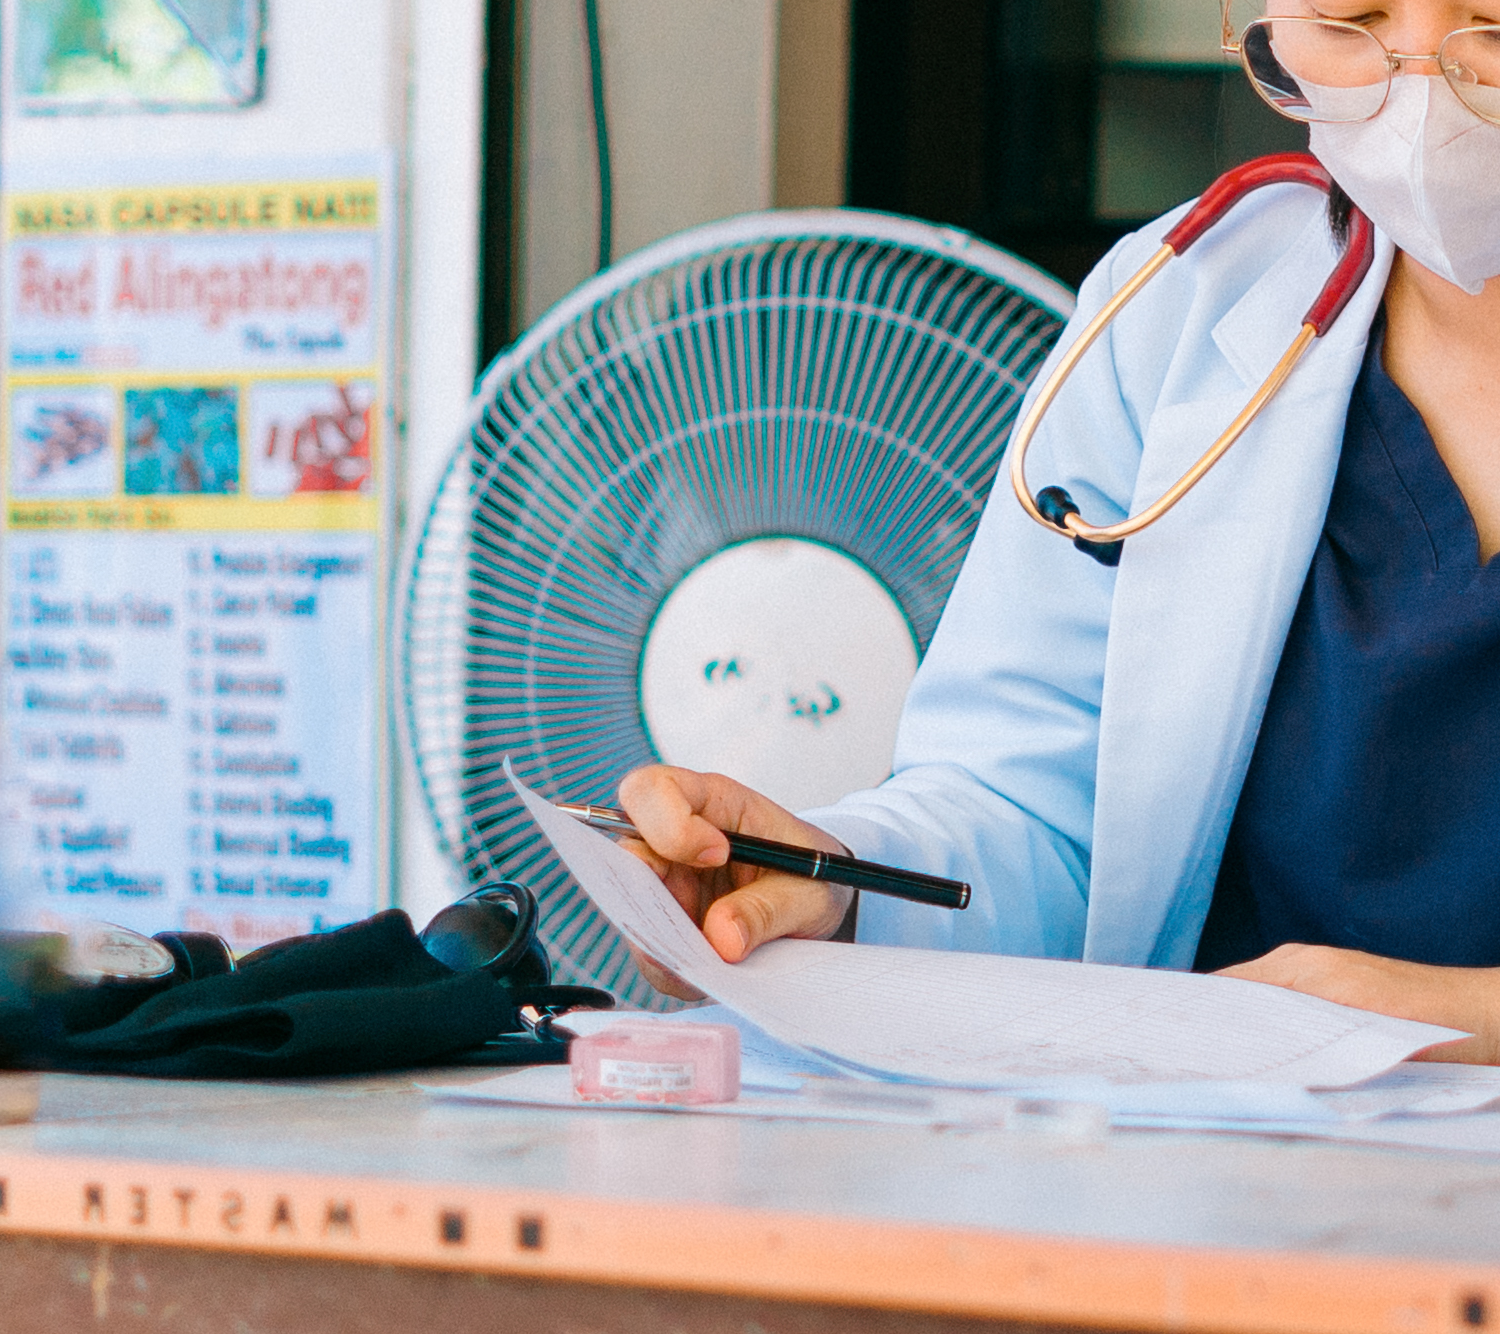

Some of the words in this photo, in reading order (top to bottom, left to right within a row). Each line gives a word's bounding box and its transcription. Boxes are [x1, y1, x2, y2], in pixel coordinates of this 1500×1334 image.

[112, 196, 279, 228] CAPSULE
[18, 246, 95, 317] Red
[113, 244, 368, 330] Alingatong
